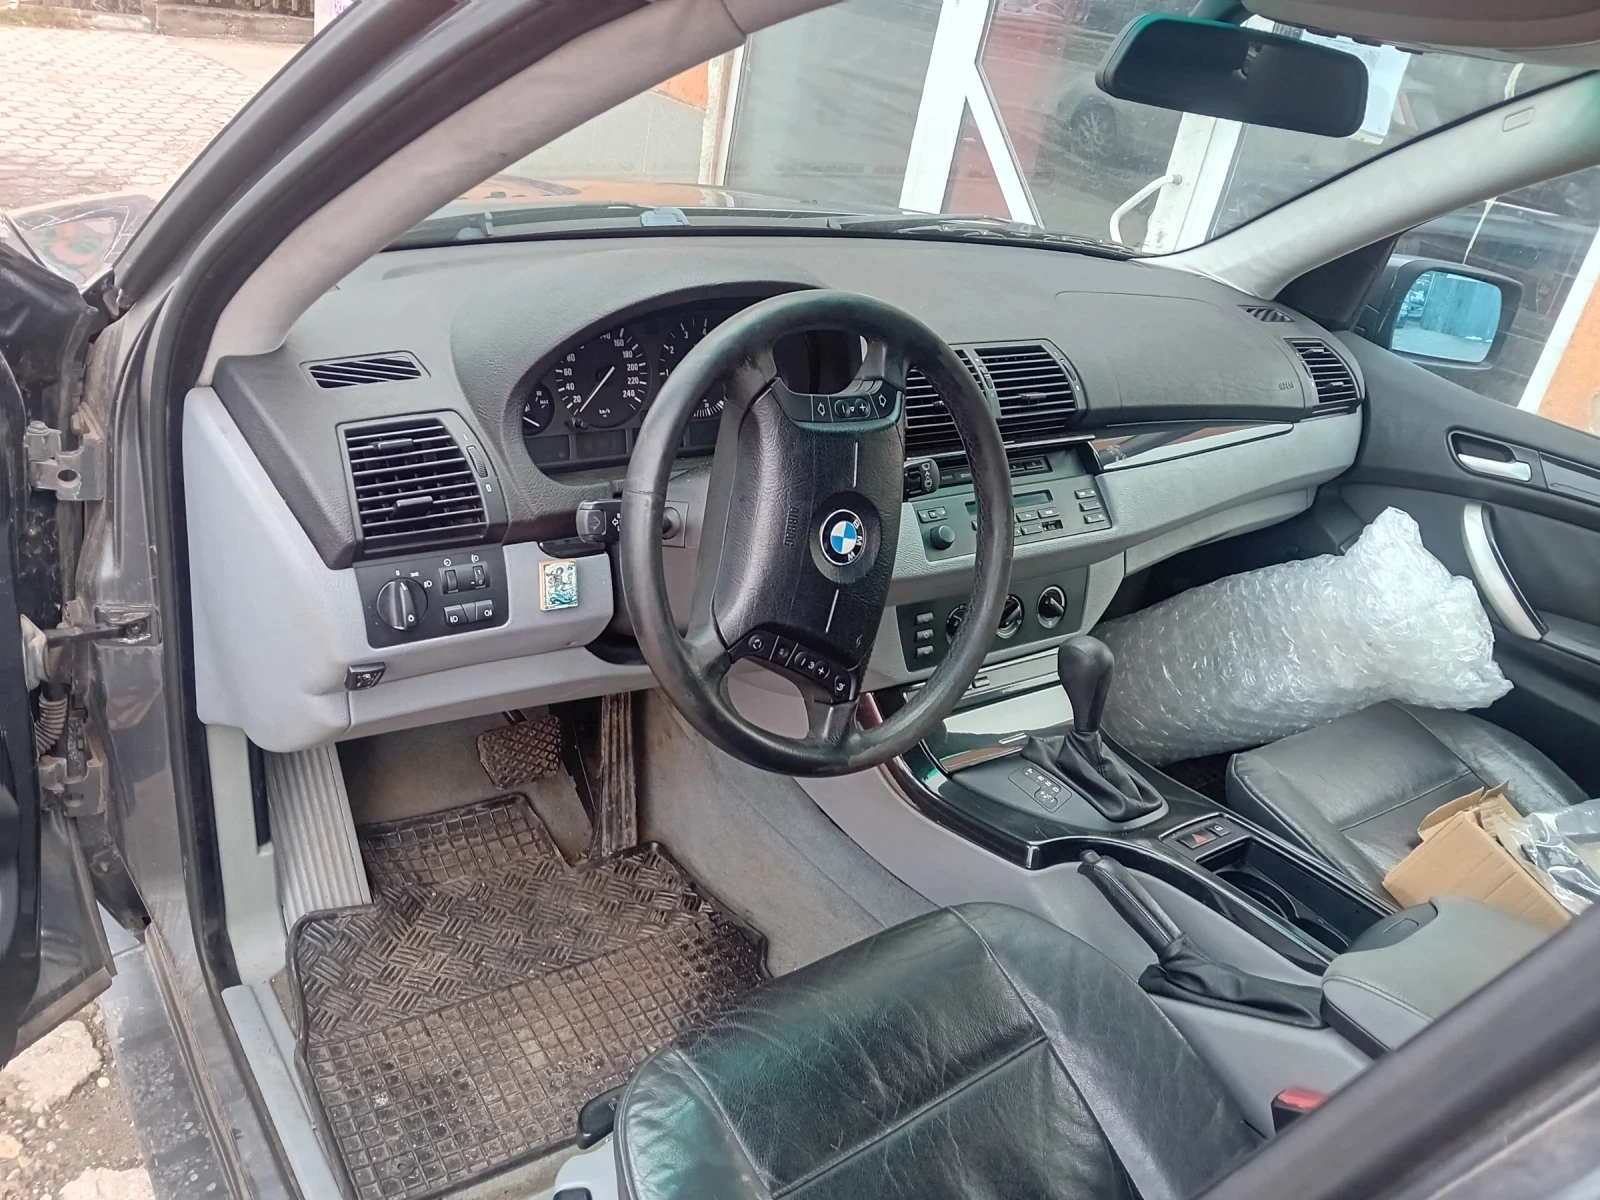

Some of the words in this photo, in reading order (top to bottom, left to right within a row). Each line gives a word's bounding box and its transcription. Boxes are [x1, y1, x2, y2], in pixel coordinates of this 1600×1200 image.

[684, 331, 689, 339] 3
[613, 339, 624, 347] 160
[622, 350, 633, 358] 180
[670, 346, 675, 354] 2
[626, 363, 639, 371] 200
[563, 368, 573, 376] 60
[627, 377, 639, 385] 220
[622, 390, 635, 398] 240
[573, 395, 581, 403] 20
[847, 518, 863, 562] BMW
